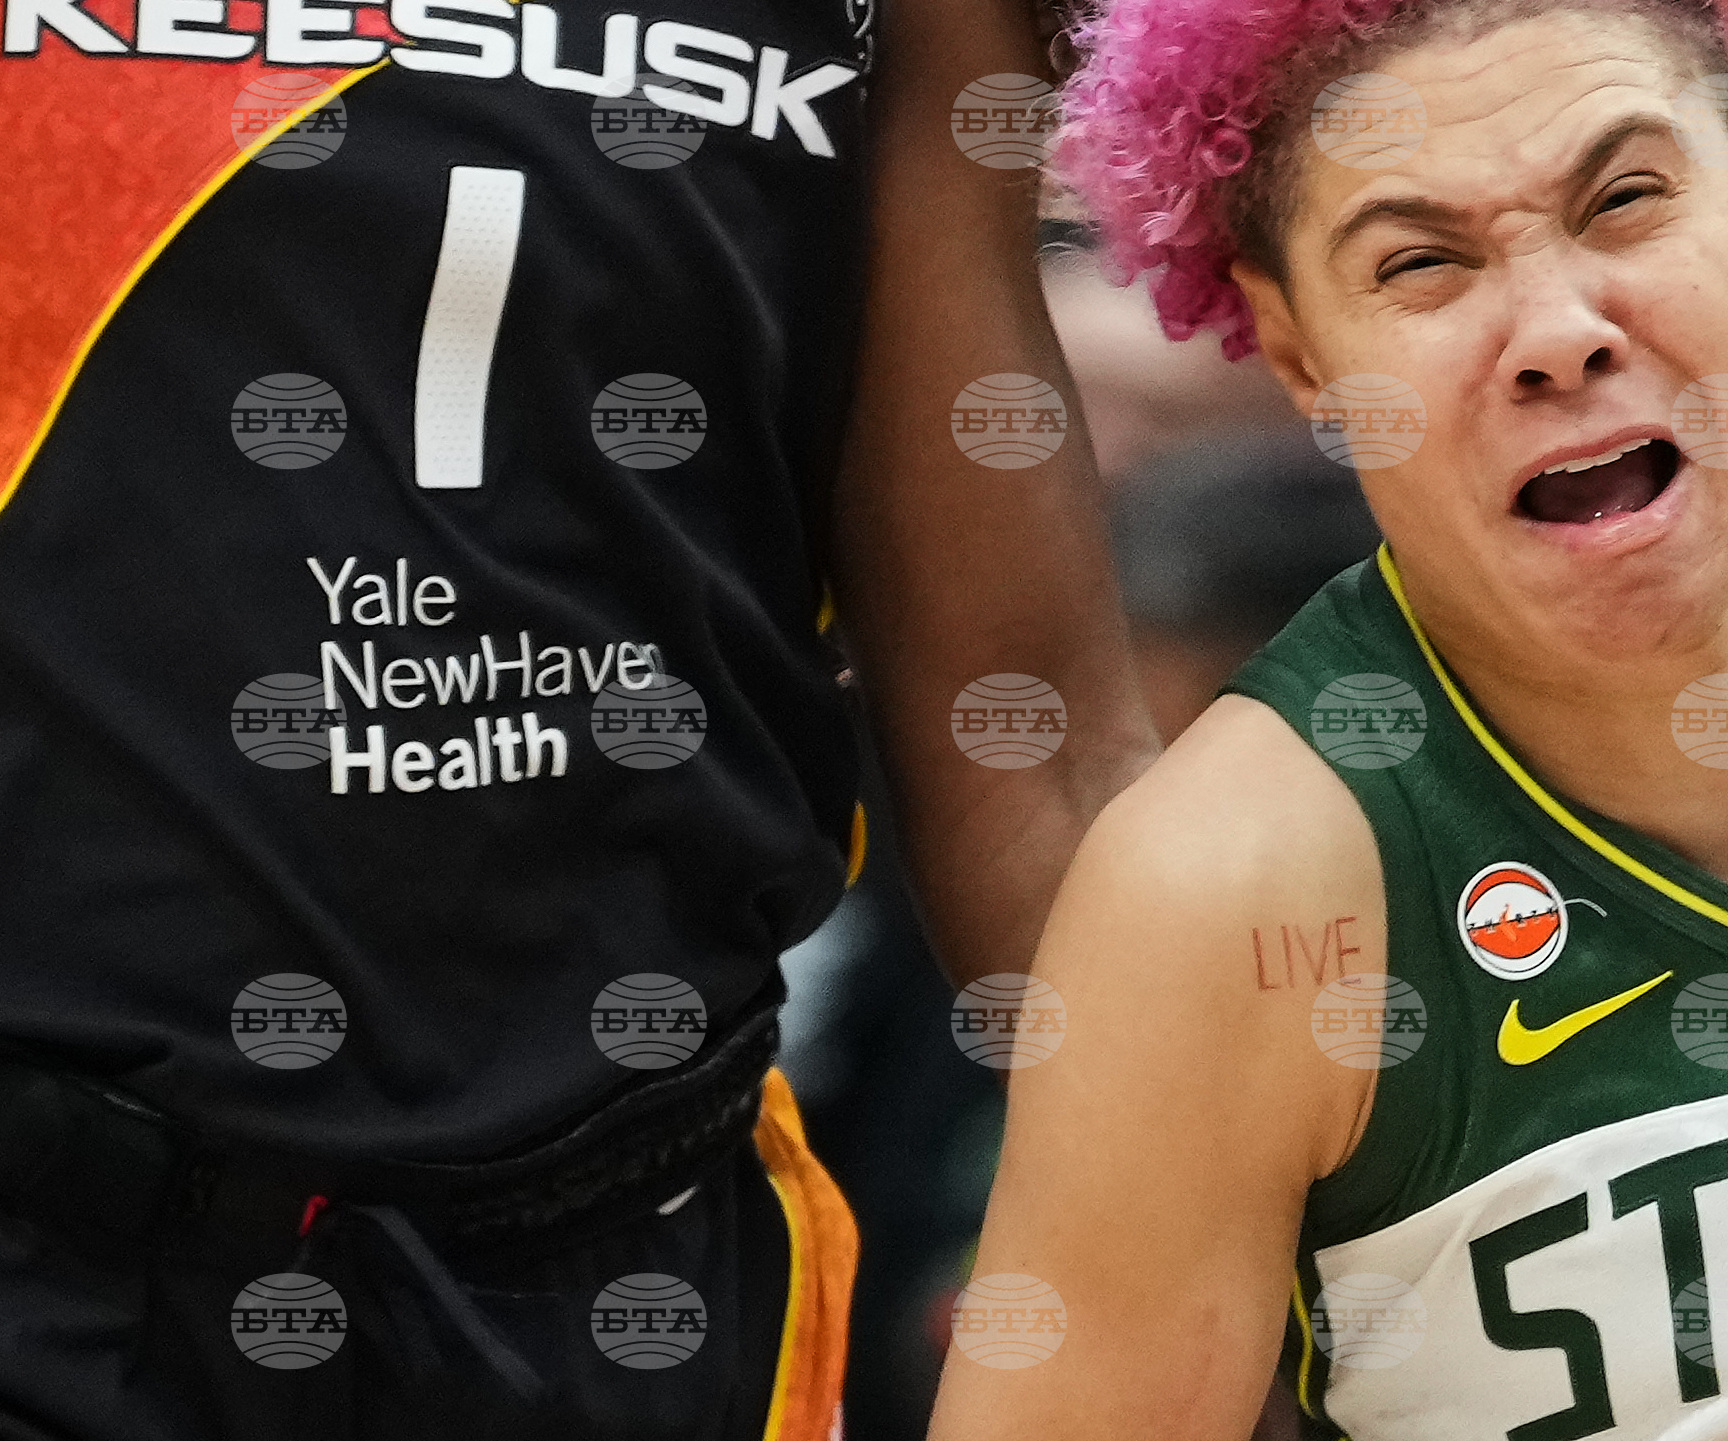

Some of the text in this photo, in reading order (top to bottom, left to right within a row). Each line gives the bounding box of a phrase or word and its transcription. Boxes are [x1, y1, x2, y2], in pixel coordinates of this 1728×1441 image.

[413, 166, 525, 488] 1
[307, 557, 457, 626] Yale
[328, 712, 568, 794] Health
[1251, 916, 1361, 990] LIVE
